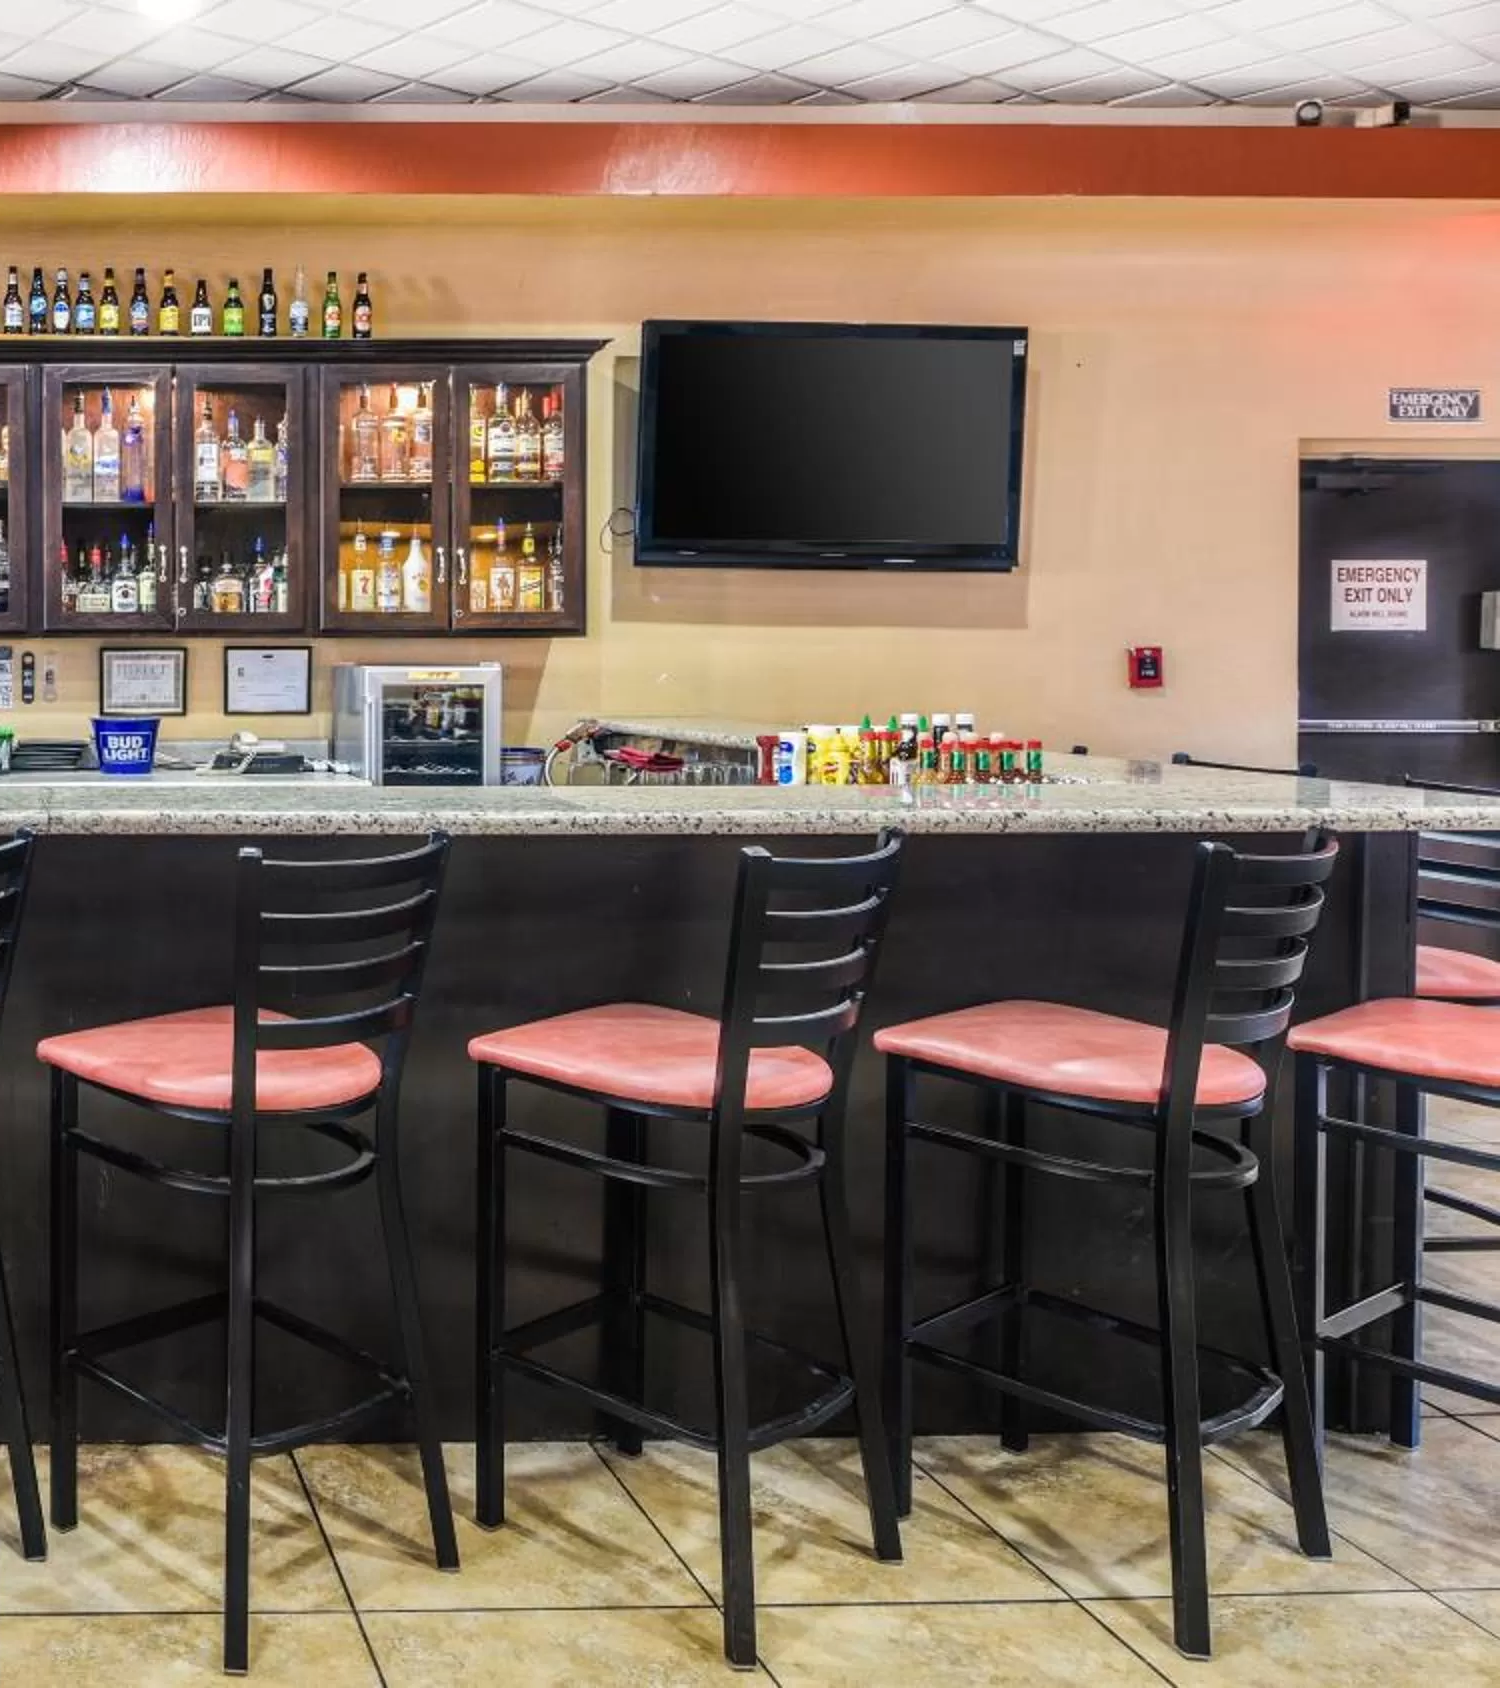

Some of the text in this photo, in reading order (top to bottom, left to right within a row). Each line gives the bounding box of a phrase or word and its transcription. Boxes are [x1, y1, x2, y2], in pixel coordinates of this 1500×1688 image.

[1392, 393, 1476, 405] EMERGENCY
[1399, 406, 1469, 417] EXIT ONLY
[1337, 567, 1421, 583] EMERGENCY
[1344, 587, 1413, 603] EXIT ONLY
[108, 735, 143, 749] BUD
[103, 747, 149, 761] LIGHT
